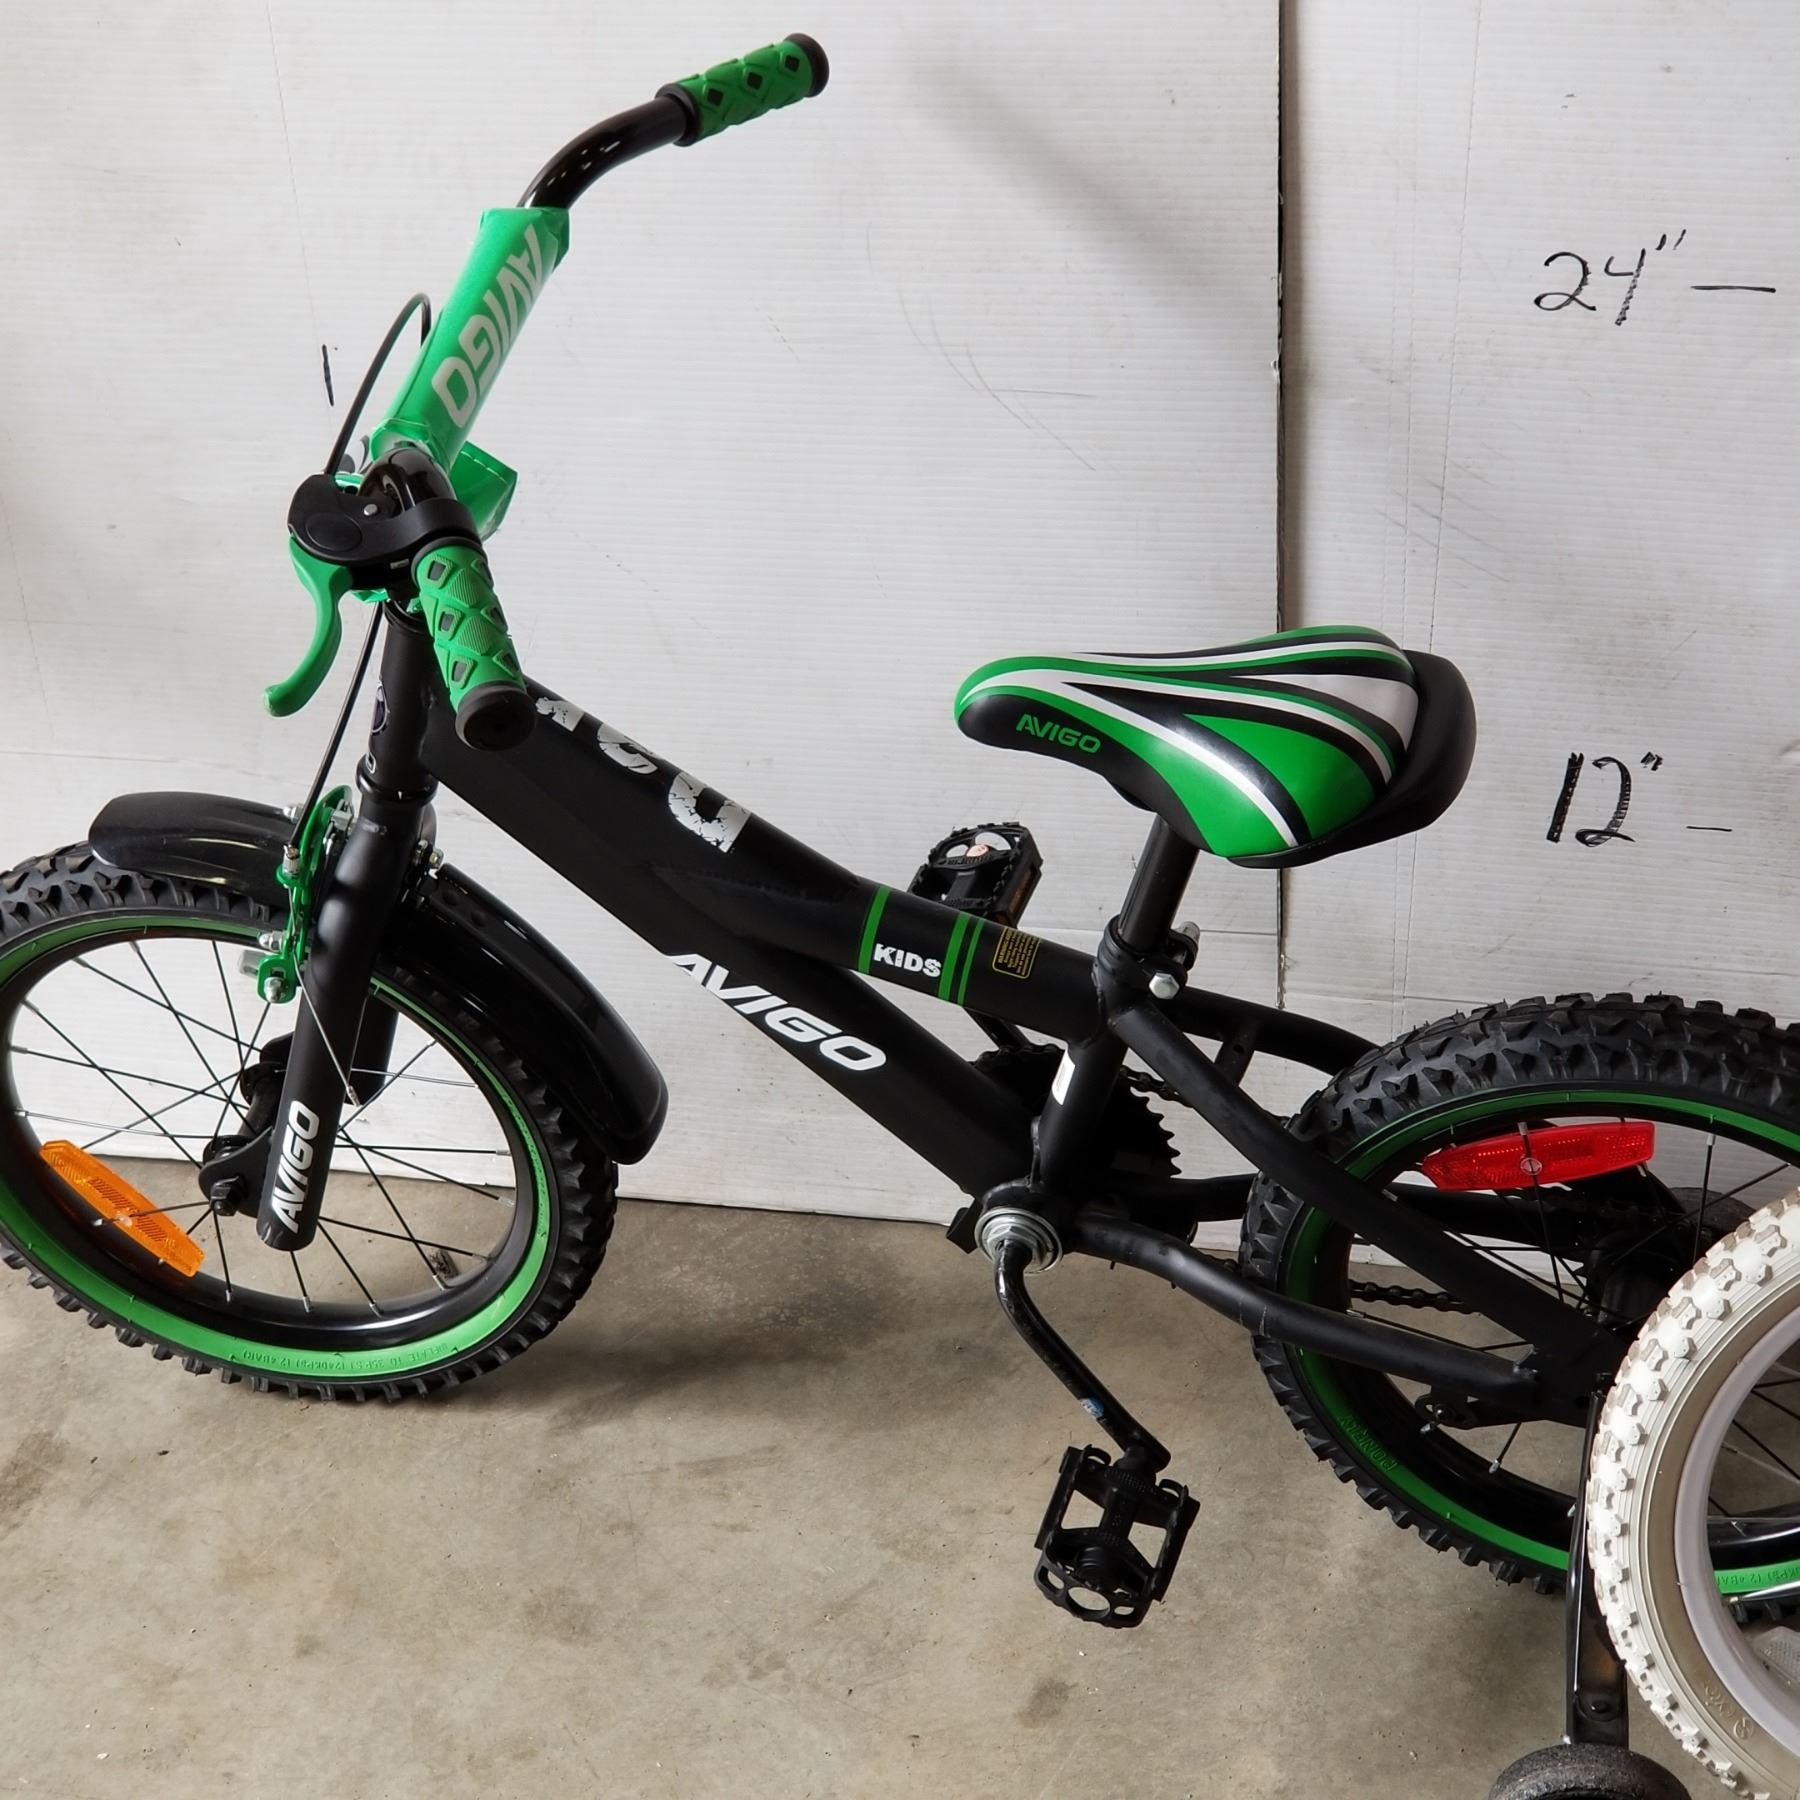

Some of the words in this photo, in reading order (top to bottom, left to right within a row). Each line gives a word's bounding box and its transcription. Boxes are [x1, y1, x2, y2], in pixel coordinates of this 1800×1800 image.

[431, 224, 545, 428] AVIGO
[1015, 713, 1101, 753] AVIGO
[667, 953, 887, 1071] AVIGO
[874, 942, 942, 977] KIDS
[271, 1100, 320, 1235] AVIGO
